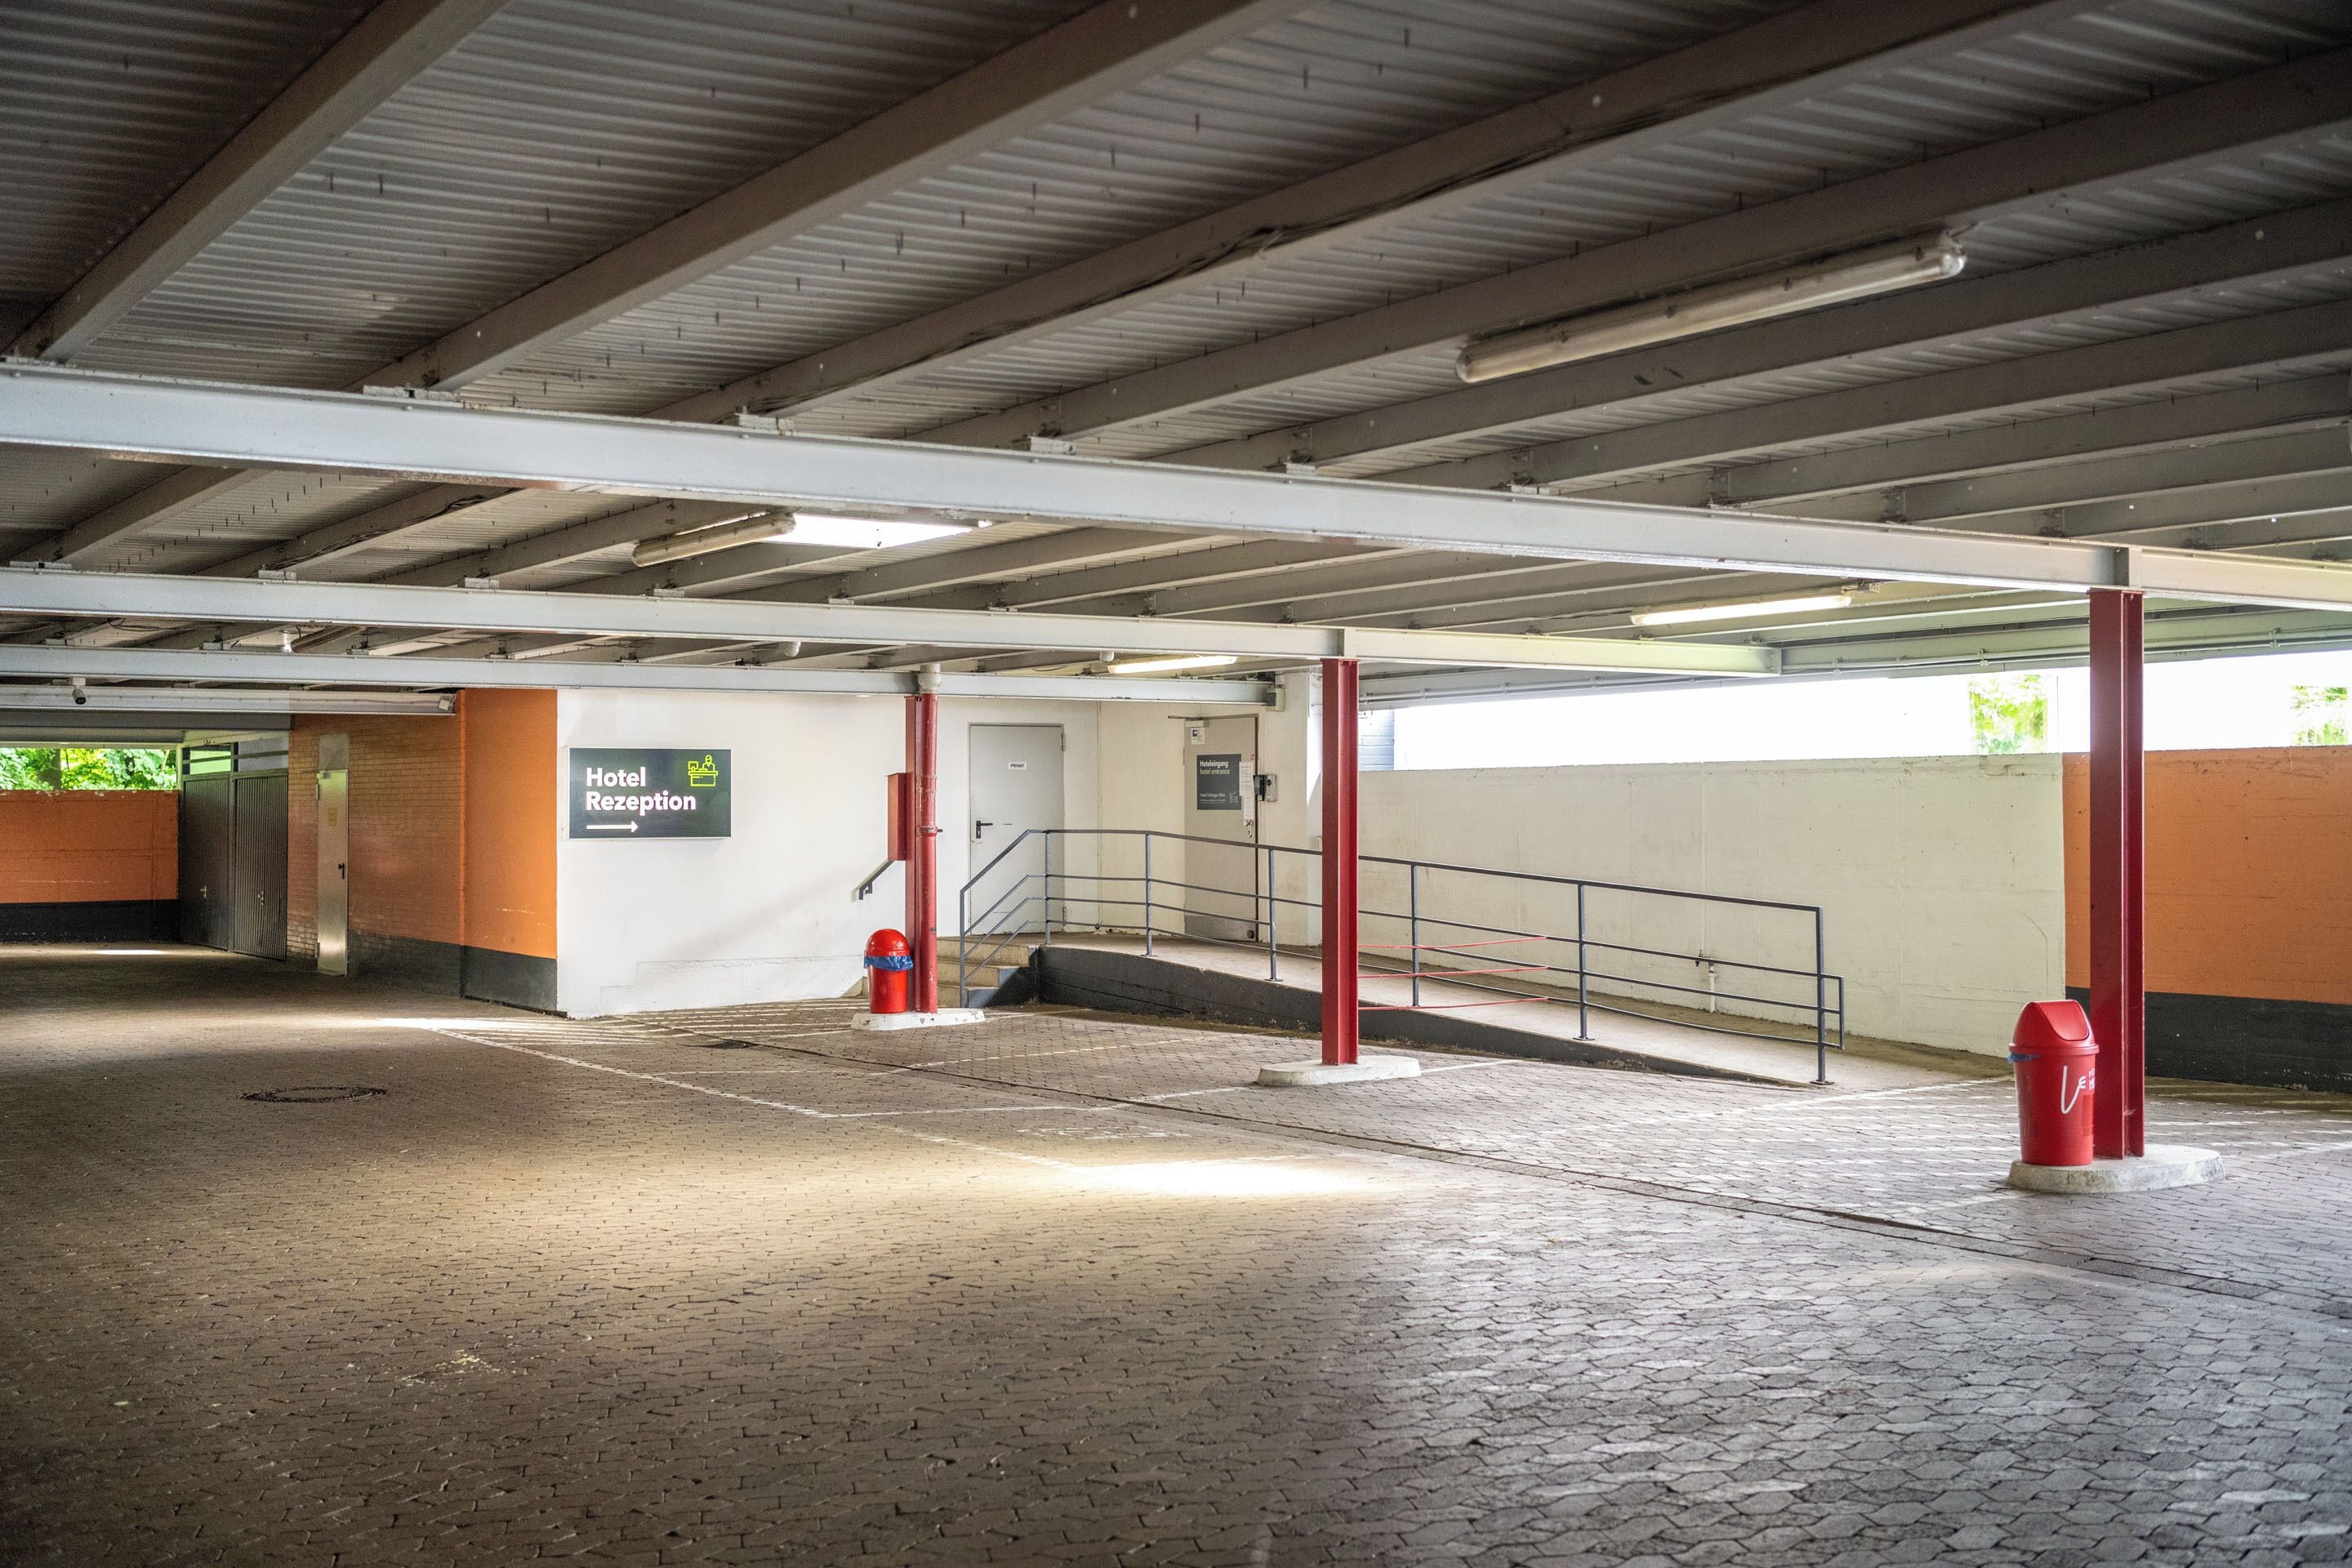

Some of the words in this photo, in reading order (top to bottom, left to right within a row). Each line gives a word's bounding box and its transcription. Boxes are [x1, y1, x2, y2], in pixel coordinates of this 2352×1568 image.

[1200, 760, 1229, 768] Hoteleingang
[586, 766, 646, 787] Hotel
[586, 791, 697, 816] Rezeption
